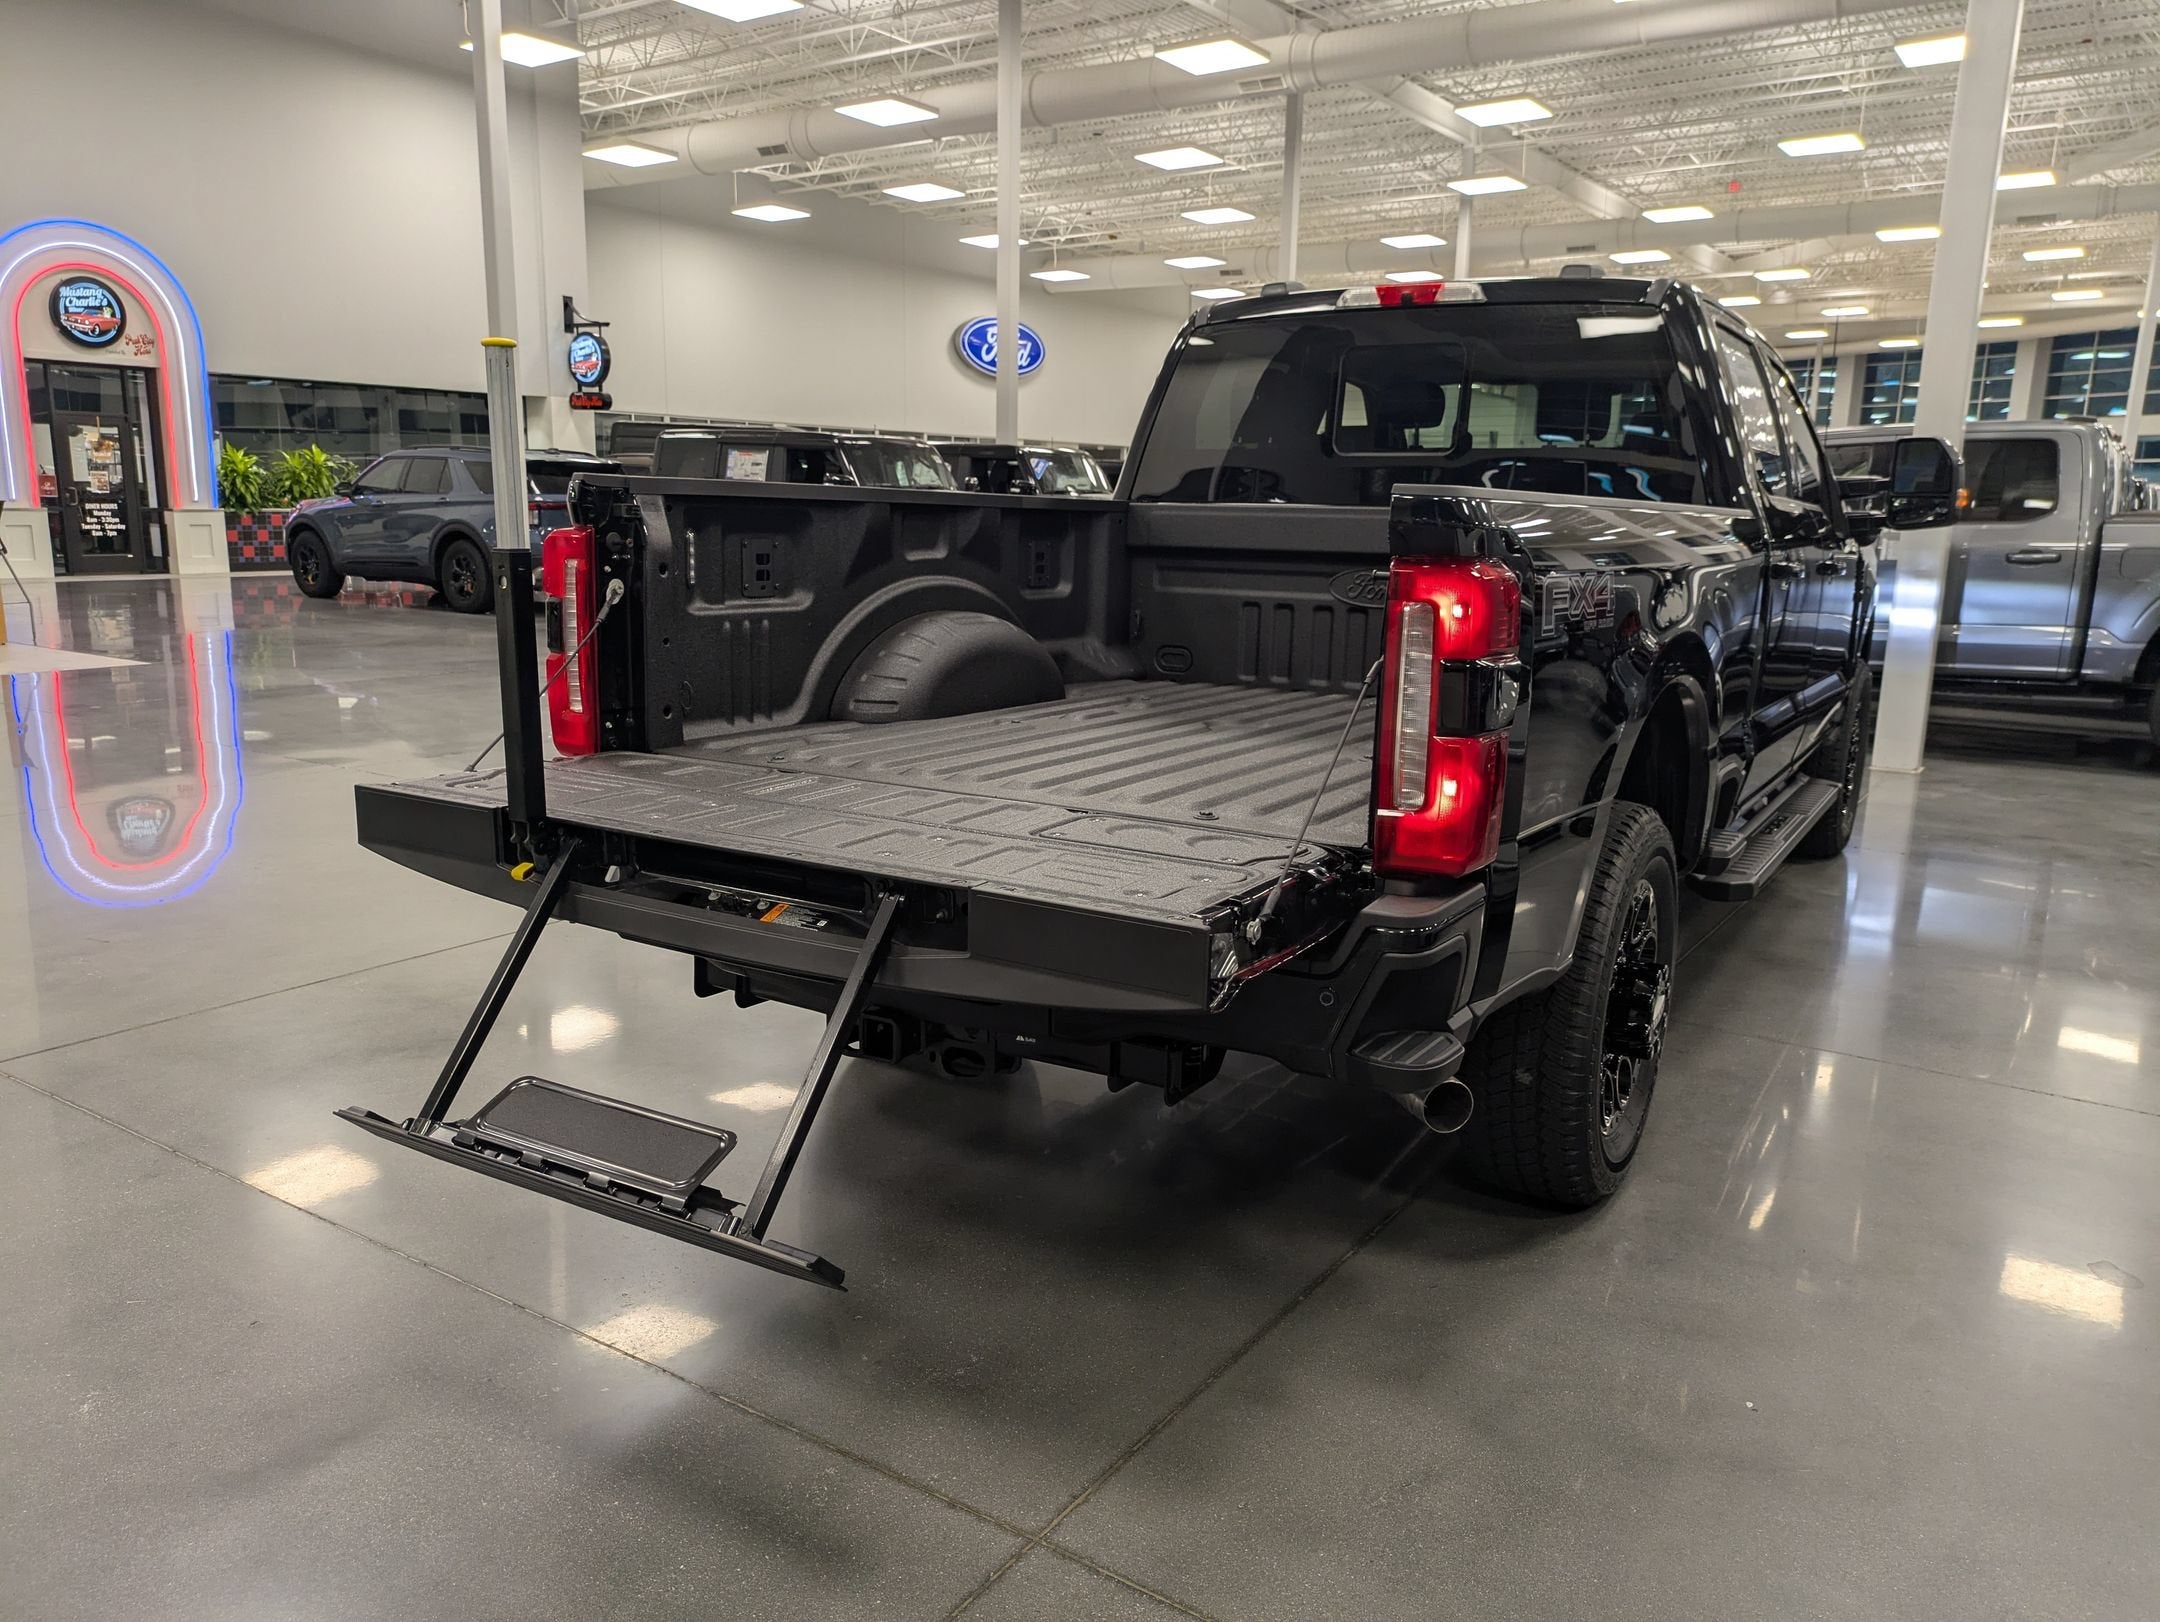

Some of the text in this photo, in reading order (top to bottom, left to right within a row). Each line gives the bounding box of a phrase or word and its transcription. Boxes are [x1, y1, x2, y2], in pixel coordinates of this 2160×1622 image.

[60, 287, 103, 299] Mustang
[65, 296, 108, 307] Charlie's
[1541, 571, 1615, 636] FX4
